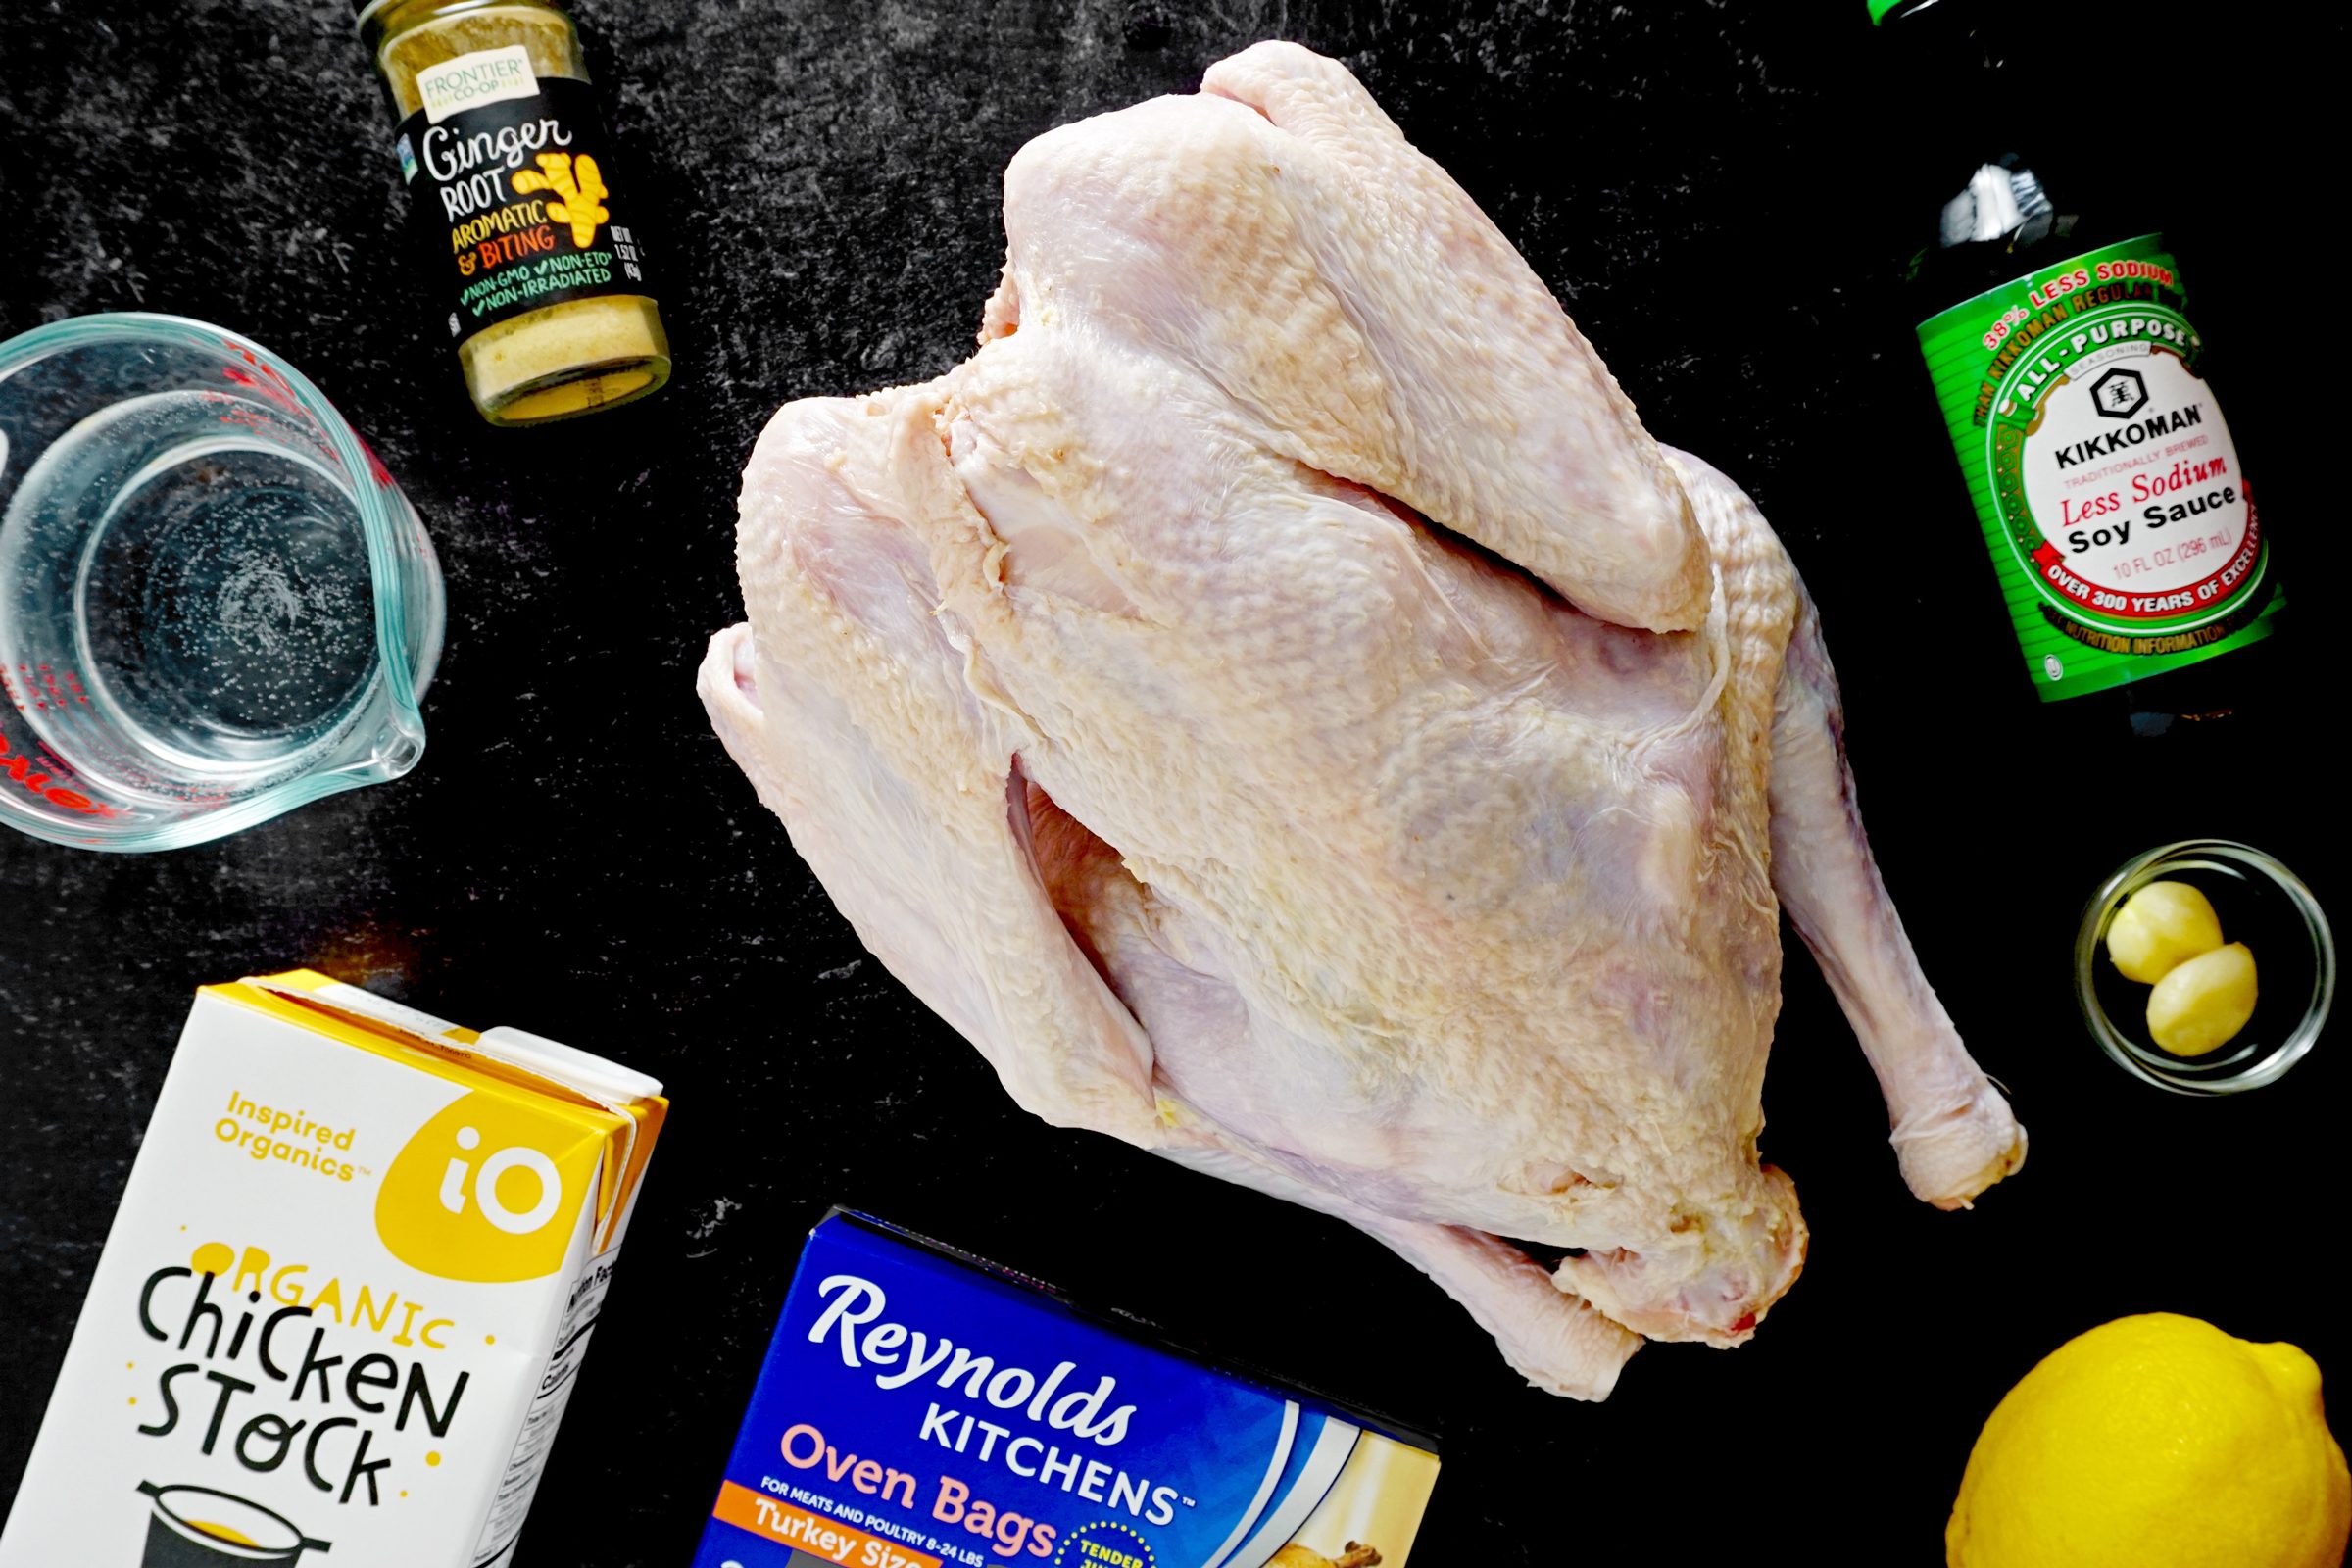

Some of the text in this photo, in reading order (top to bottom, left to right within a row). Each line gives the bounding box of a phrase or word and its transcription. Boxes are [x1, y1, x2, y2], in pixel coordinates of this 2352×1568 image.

[424, 59, 520, 99] FRONTIER
[454, 80, 499, 101] CO-OP
[423, 119, 572, 181] Ginger
[440, 165, 506, 222] ROOT
[452, 200, 548, 254] AROMATIC
[458, 225, 555, 276] & BITING
[466, 265, 530, 301] NON-GMO
[485, 269, 611, 311] NON-IRRADIATED
[1982, 260, 2174, 352] 38% LESS SODIUM
[1974, 381, 1996, 426] THAN
[1987, 302, 2069, 380] KIKKOMAN
[2070, 343, 2149, 375] SEASONING
[2055, 404, 2203, 469] KIKKOMAN
[2065, 434, 2210, 489] TRADITIONALLY BREWED
[2060, 456, 2228, 527] Less Sodium
[2068, 486, 2235, 554] Soy Sauce
[2047, 564, 2090, 601] OVER
[2091, 590, 2127, 611] 300
[2132, 590, 2195, 612] YEARS
[2197, 579, 2221, 601] OF
[2113, 563, 2131, 581] 10
[2133, 557, 2151, 574] FL
[2155, 547, 2176, 567] OZ
[2177, 538, 2208, 564] (296
[215, 1118, 355, 1182] Organics
[227, 1090, 356, 1152] Inspired
[439, 1126, 562, 1235] iO
[191, 1242, 455, 1349] ORGANIC
[808, 1274, 1137, 1446] Reynolds
[780, 1423, 1058, 1558] Oven Bags
[918, 1402, 1179, 1526] KITCHENS
[755, 1497, 858, 1562] Turkey
[760, 1475, 985, 1568] FOR MEATS AND POULTRY 8-24 LBS
[1079, 1539, 1144, 1568] TENDER
